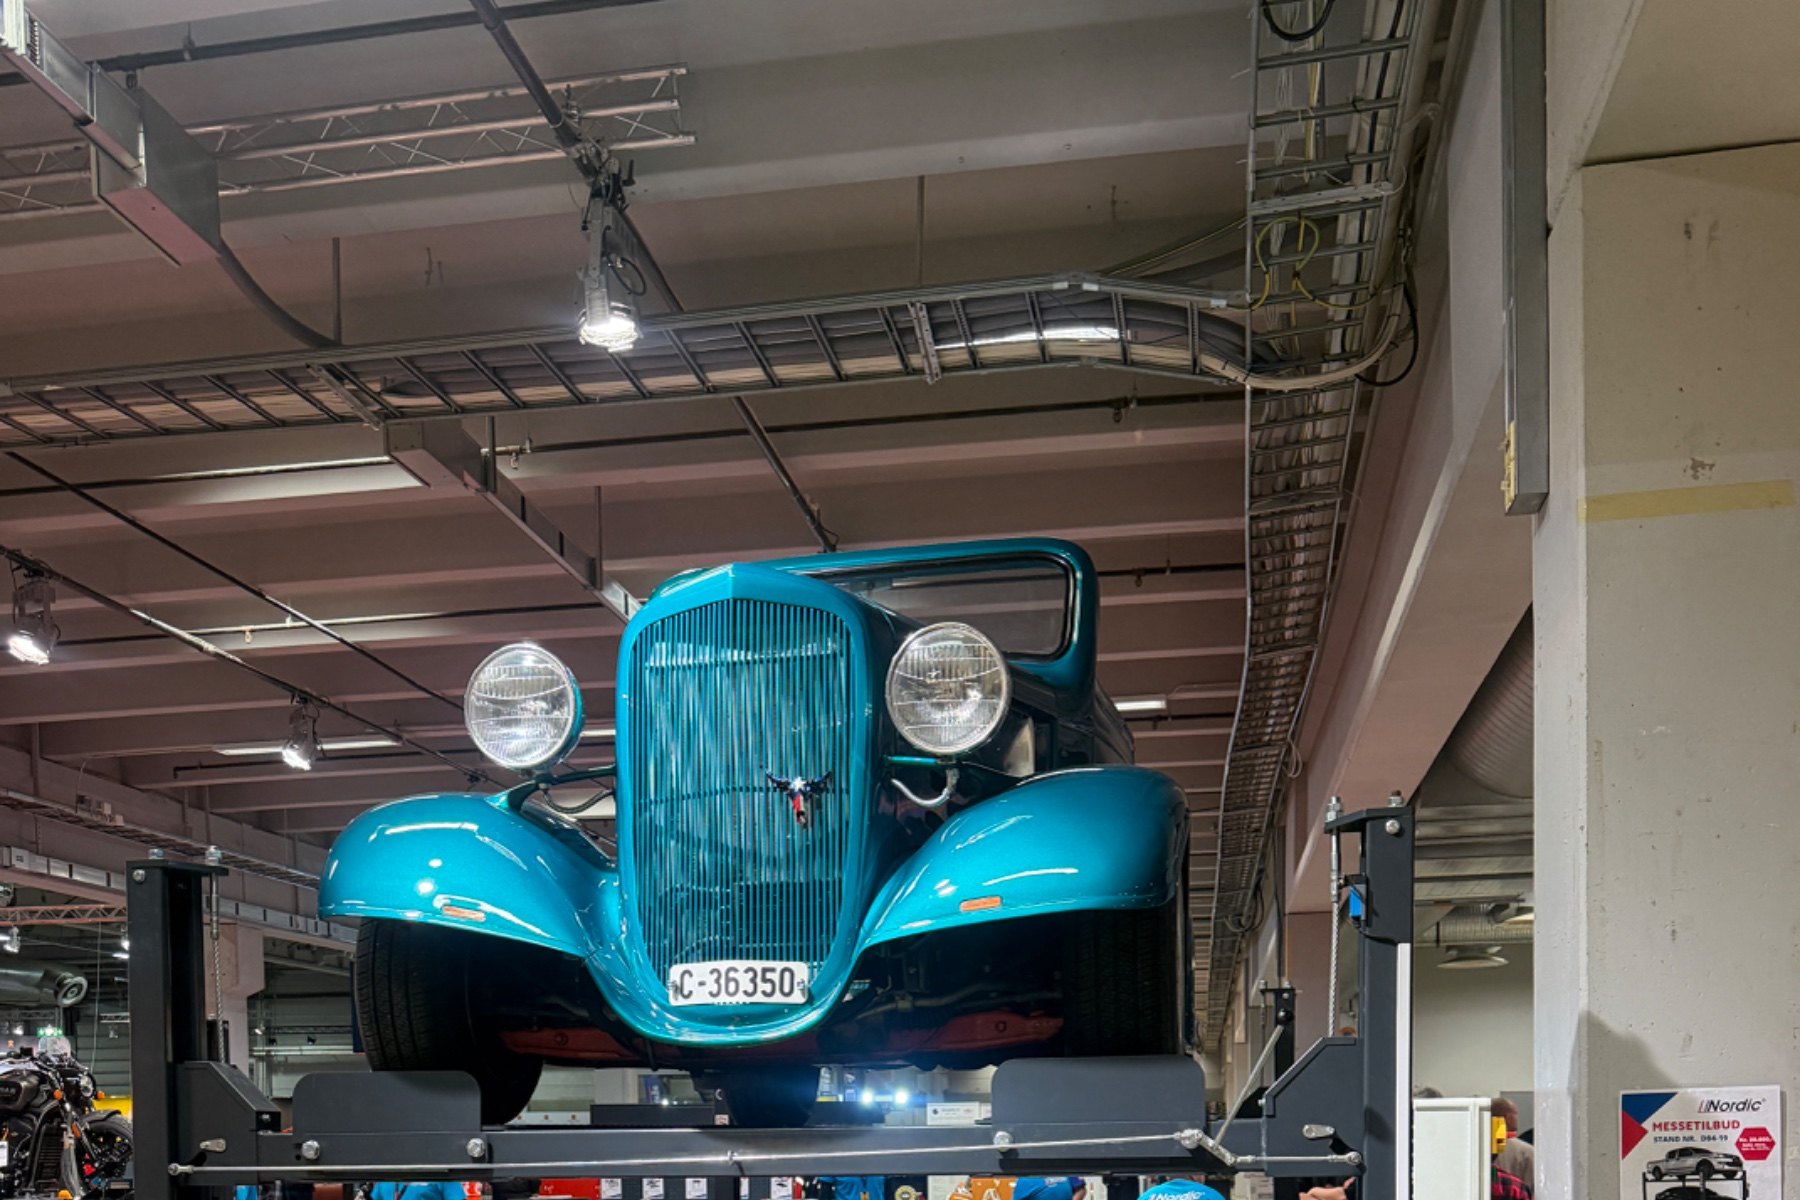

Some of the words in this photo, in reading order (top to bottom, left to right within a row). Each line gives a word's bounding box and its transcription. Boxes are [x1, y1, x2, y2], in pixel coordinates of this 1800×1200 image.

[680, 966, 795, 1000] C-36350
[1705, 1098, 1762, 1113] Nordic
[1652, 1120, 1740, 1132] MESSETILBUD
[1653, 1135, 1681, 1143] STAND
